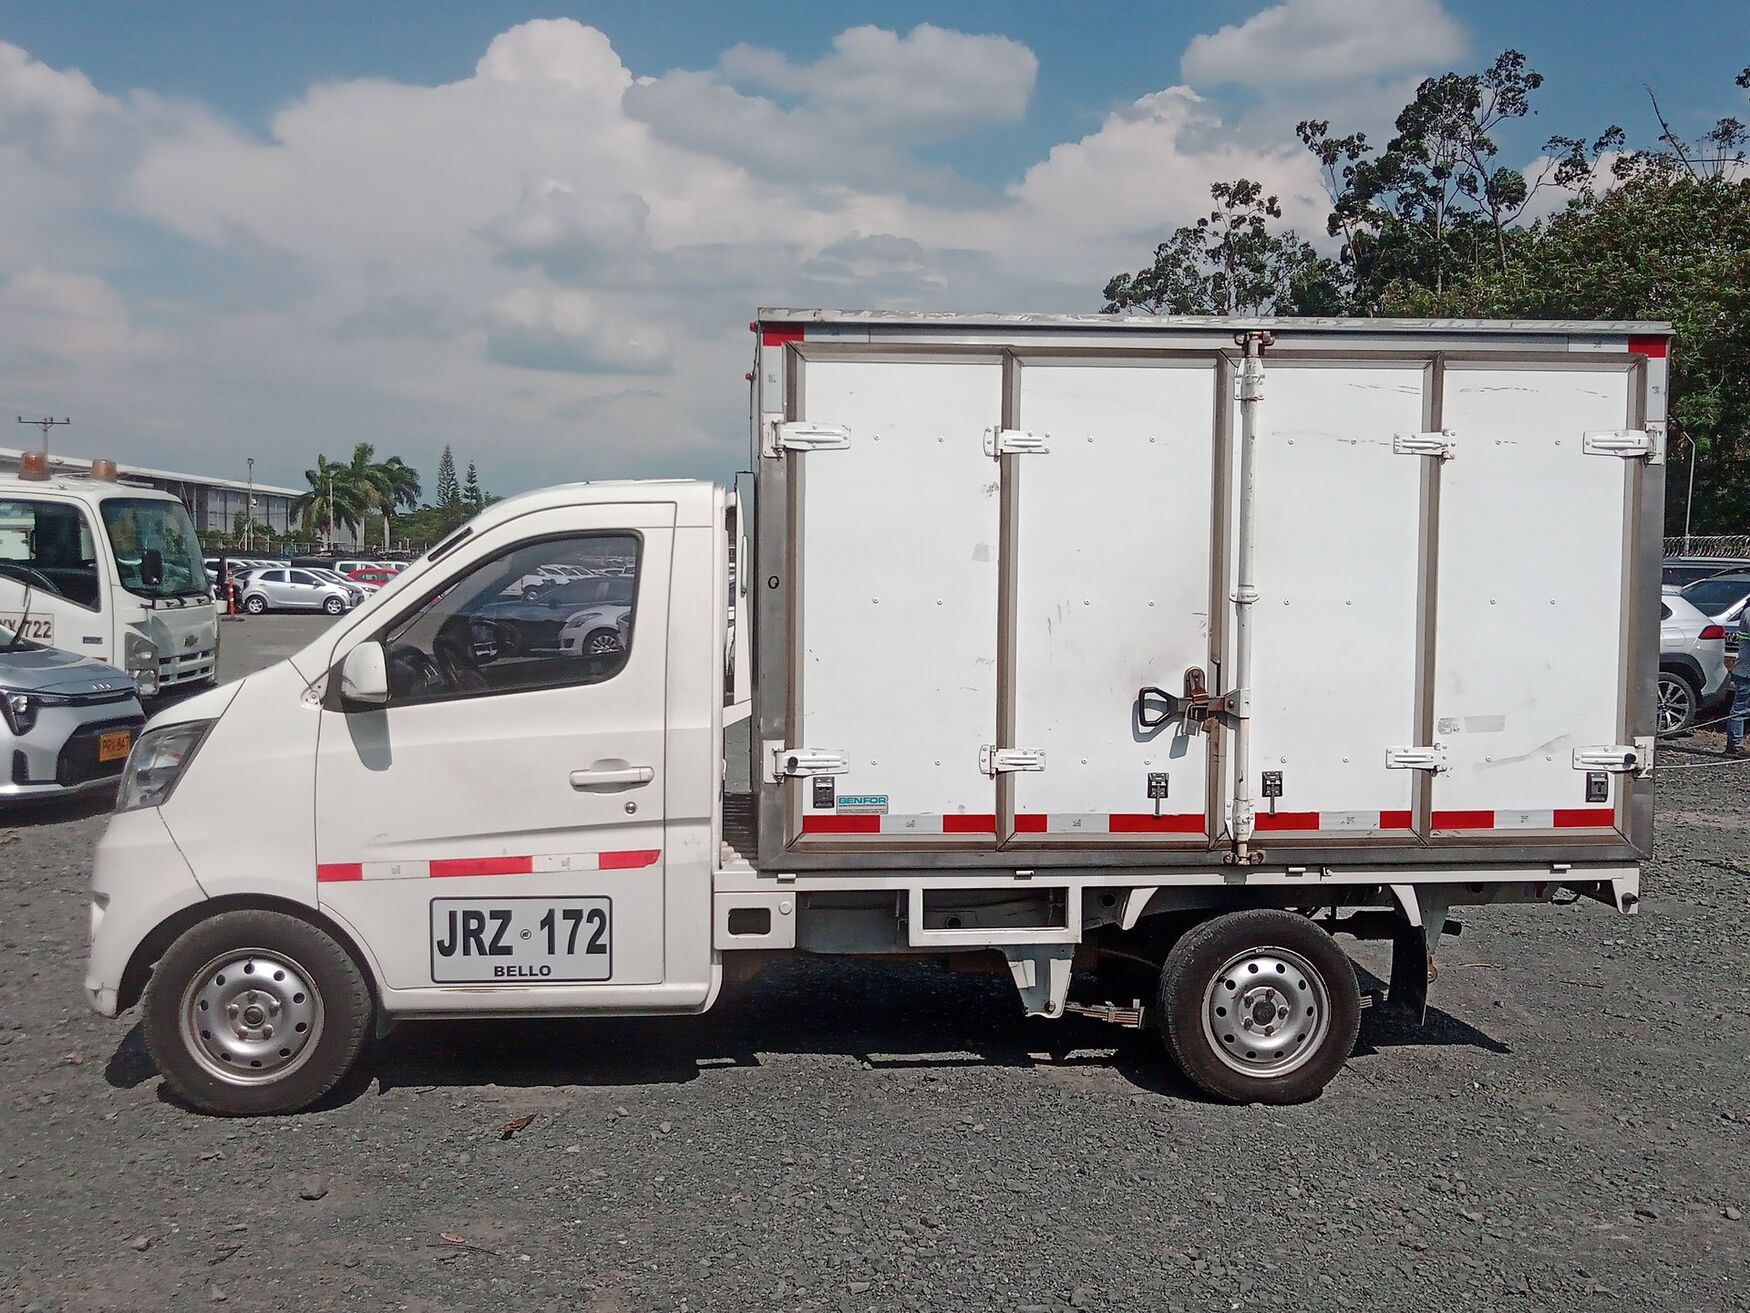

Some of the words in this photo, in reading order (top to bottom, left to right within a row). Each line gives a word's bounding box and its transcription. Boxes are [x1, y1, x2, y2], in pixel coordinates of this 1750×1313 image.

[24, 620, 52, 638] 722
[436, 909, 513, 957] JRZ
[540, 907, 608, 955] 172
[494, 965, 552, 977] BELLO
